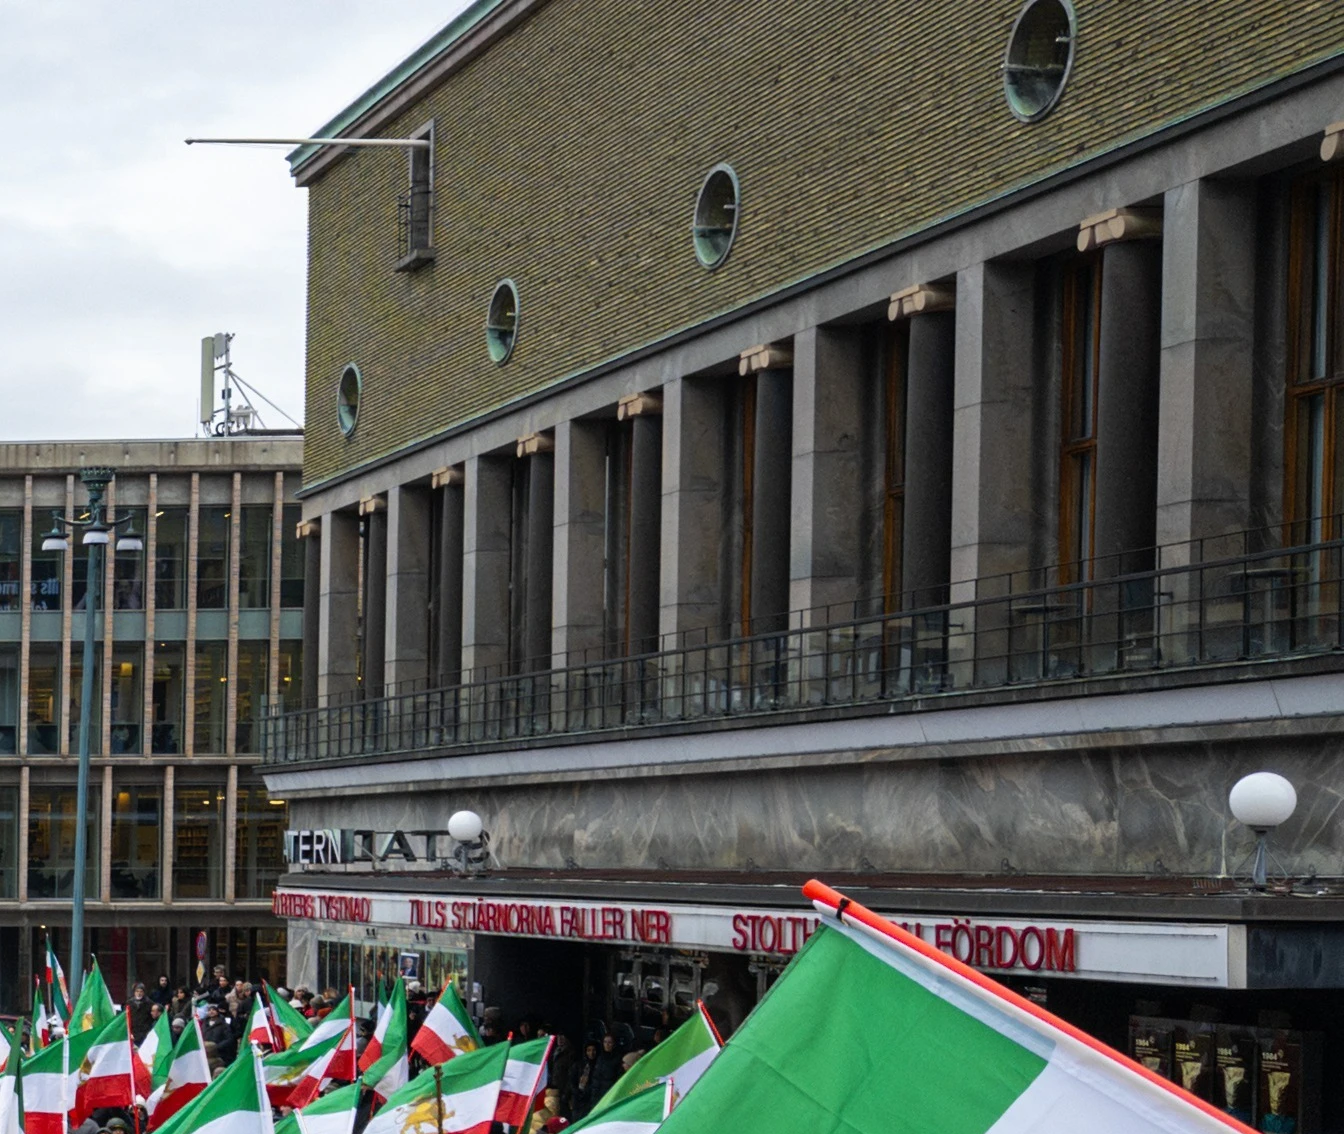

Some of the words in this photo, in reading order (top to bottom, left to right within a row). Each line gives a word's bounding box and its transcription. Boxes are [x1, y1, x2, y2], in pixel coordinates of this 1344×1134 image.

[409, 899, 447, 930] TILLS
[452, 897, 556, 936] STJÄRNORNA
[560, 905, 627, 940] FALLER
[631, 908, 672, 945] NER
[935, 918, 1076, 973] FÖRDOM
